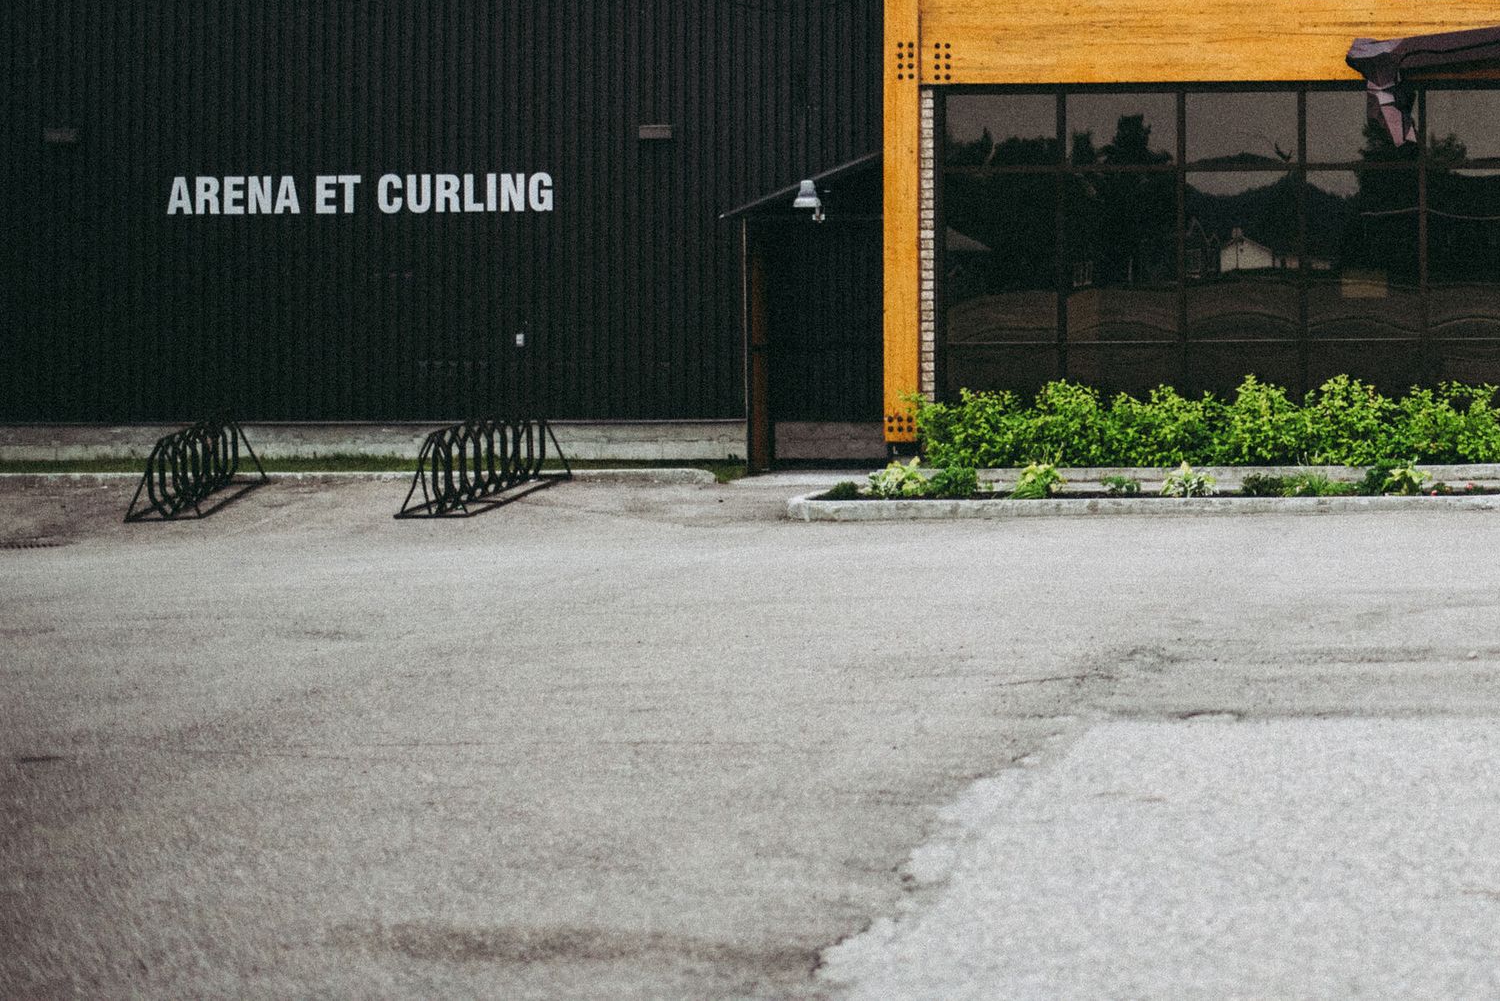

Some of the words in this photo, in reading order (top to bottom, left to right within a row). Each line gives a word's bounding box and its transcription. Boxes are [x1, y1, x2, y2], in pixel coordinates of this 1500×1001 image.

[167, 175, 301, 215] ARENA
[315, 174, 362, 214] ET
[377, 171, 555, 214] CURLING
